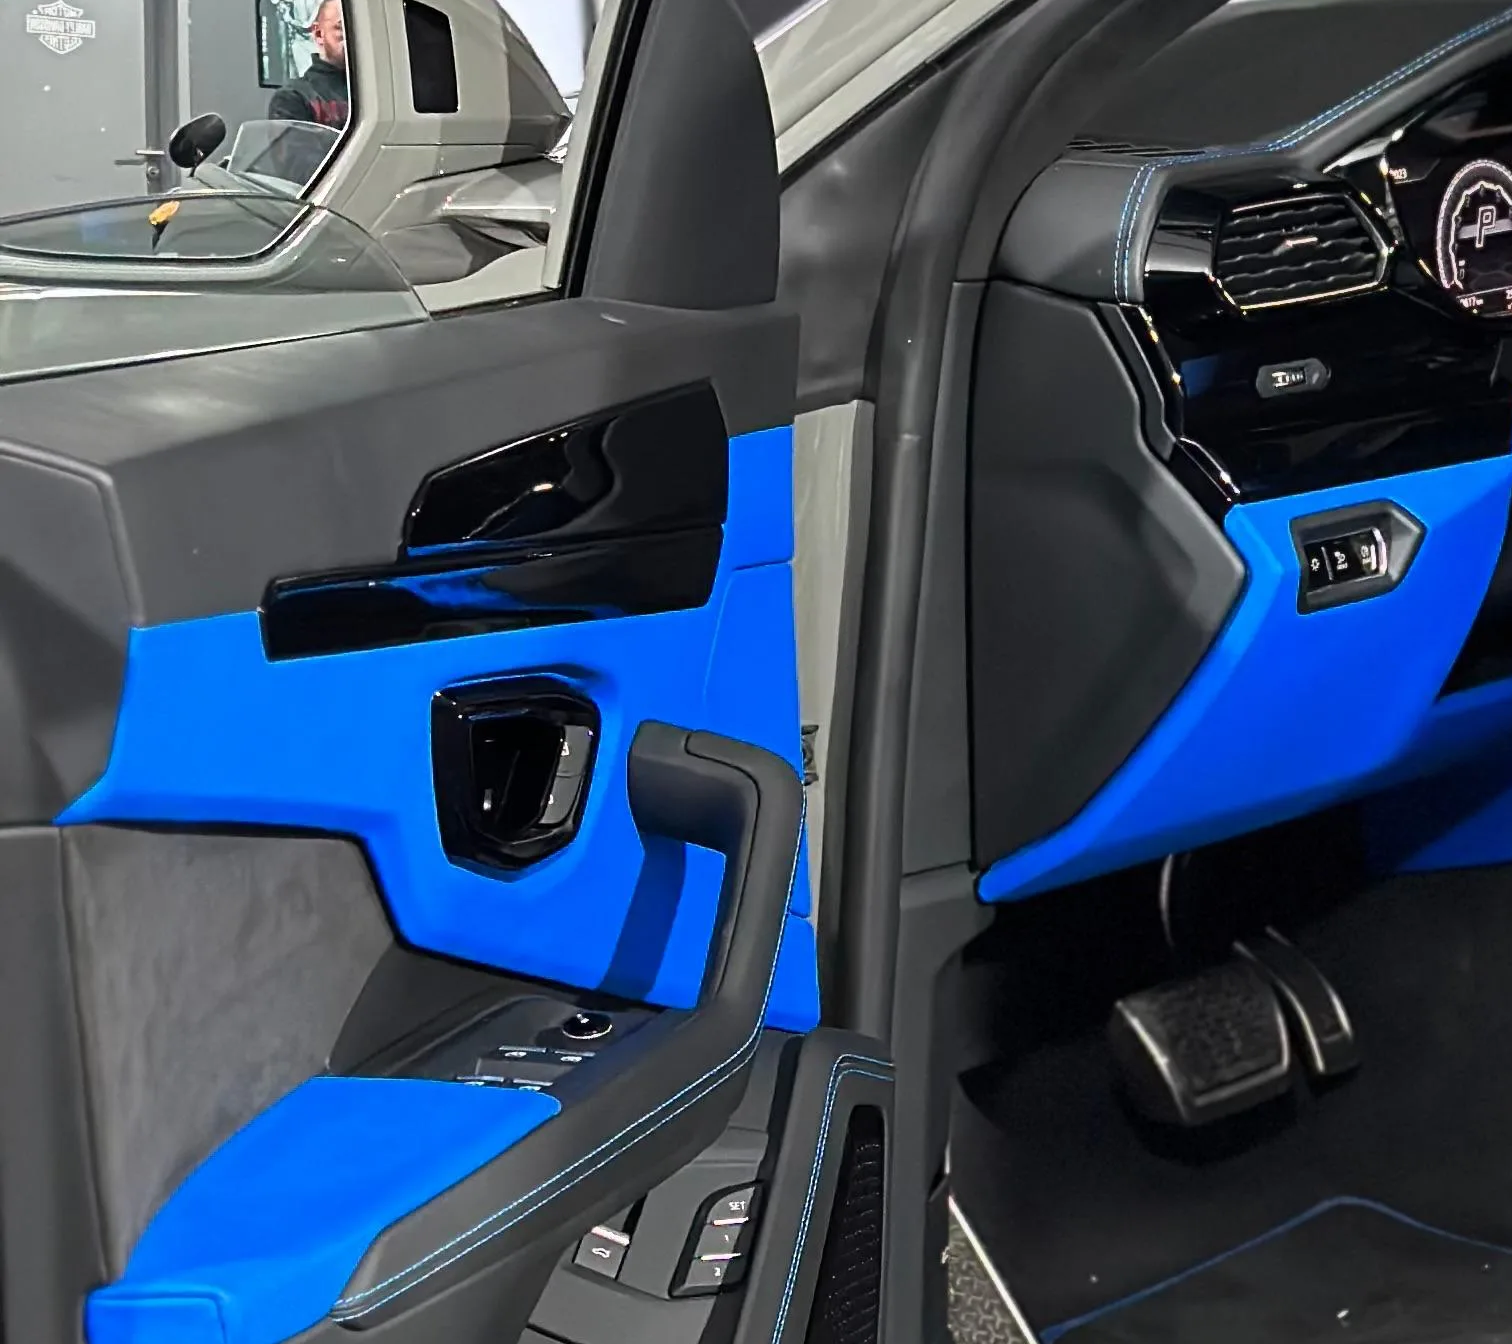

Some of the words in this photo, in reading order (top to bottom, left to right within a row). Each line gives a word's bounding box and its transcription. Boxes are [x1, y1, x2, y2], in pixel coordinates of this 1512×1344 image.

[1475, 205, 1497, 248] P
[729, 1201, 746, 1211] SET
[714, 1267, 721, 1277] 2
